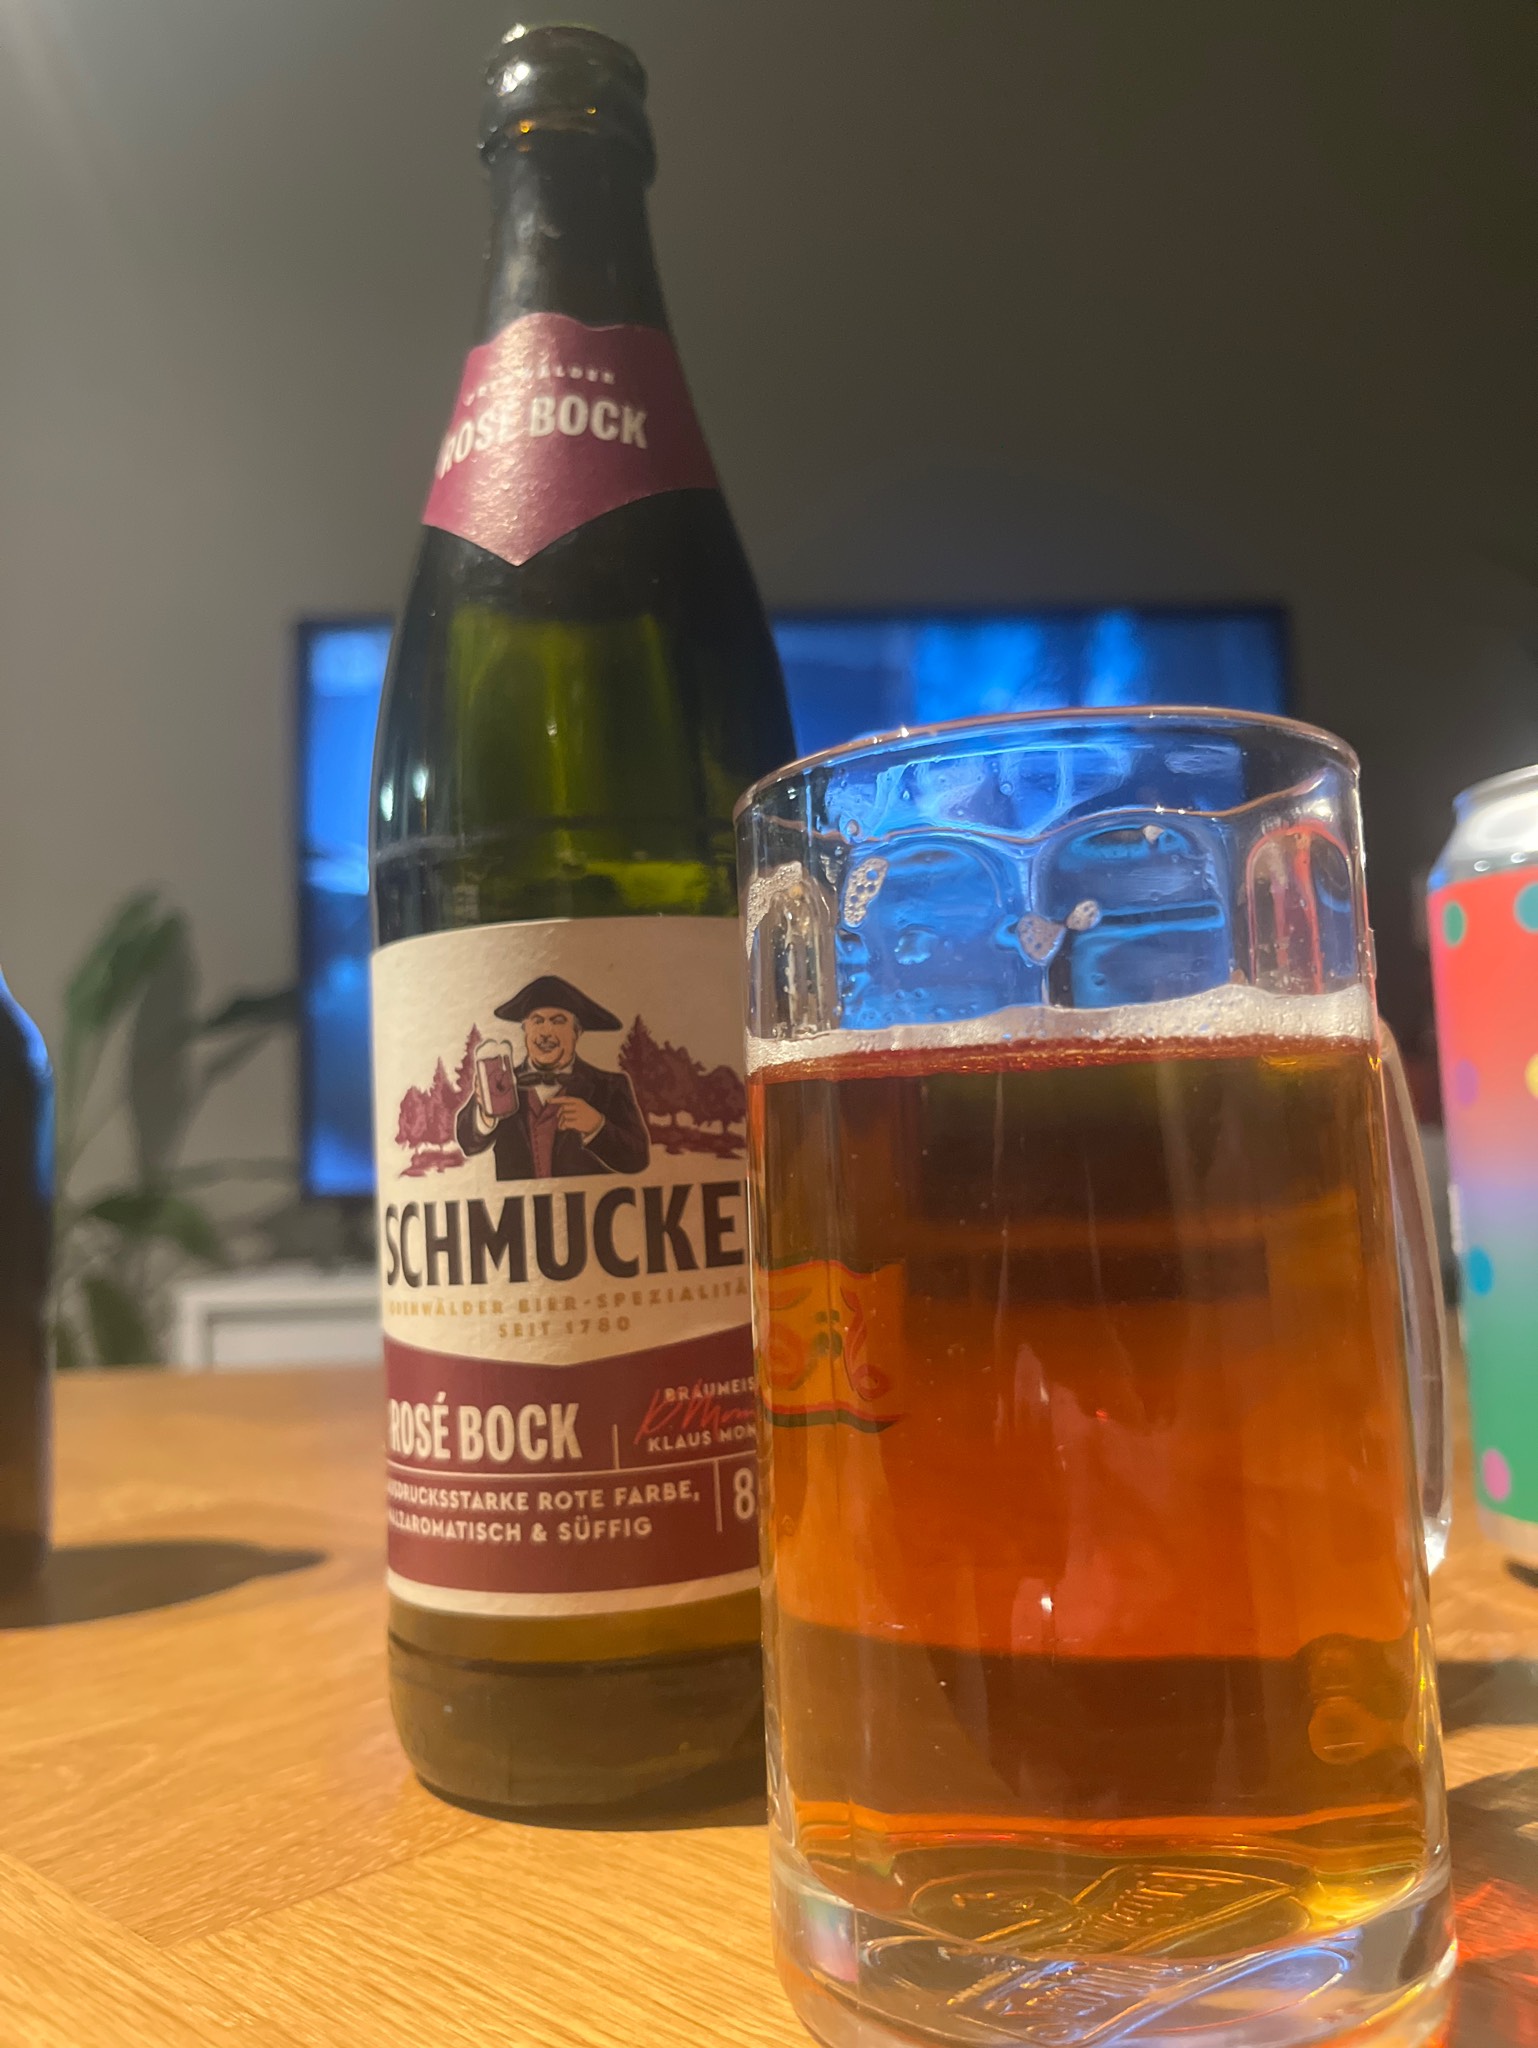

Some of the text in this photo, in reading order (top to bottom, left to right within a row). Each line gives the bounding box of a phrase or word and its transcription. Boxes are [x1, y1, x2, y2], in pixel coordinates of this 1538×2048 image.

[529, 394, 648, 450] BOCK
[385, 1180, 748, 1288] SCHMUCKE
[498, 1315, 631, 1339] SEIT 1780
[389, 1391, 452, 1461] ROSÉ
[459, 1402, 583, 1464] BOCK
[648, 1431, 712, 1453] KLAUS
[538, 1492, 605, 1512] ROTE
[614, 1479, 701, 1506] FARBE,
[531, 1521, 549, 1543] &
[558, 1515, 653, 1542] SÜFFIG
